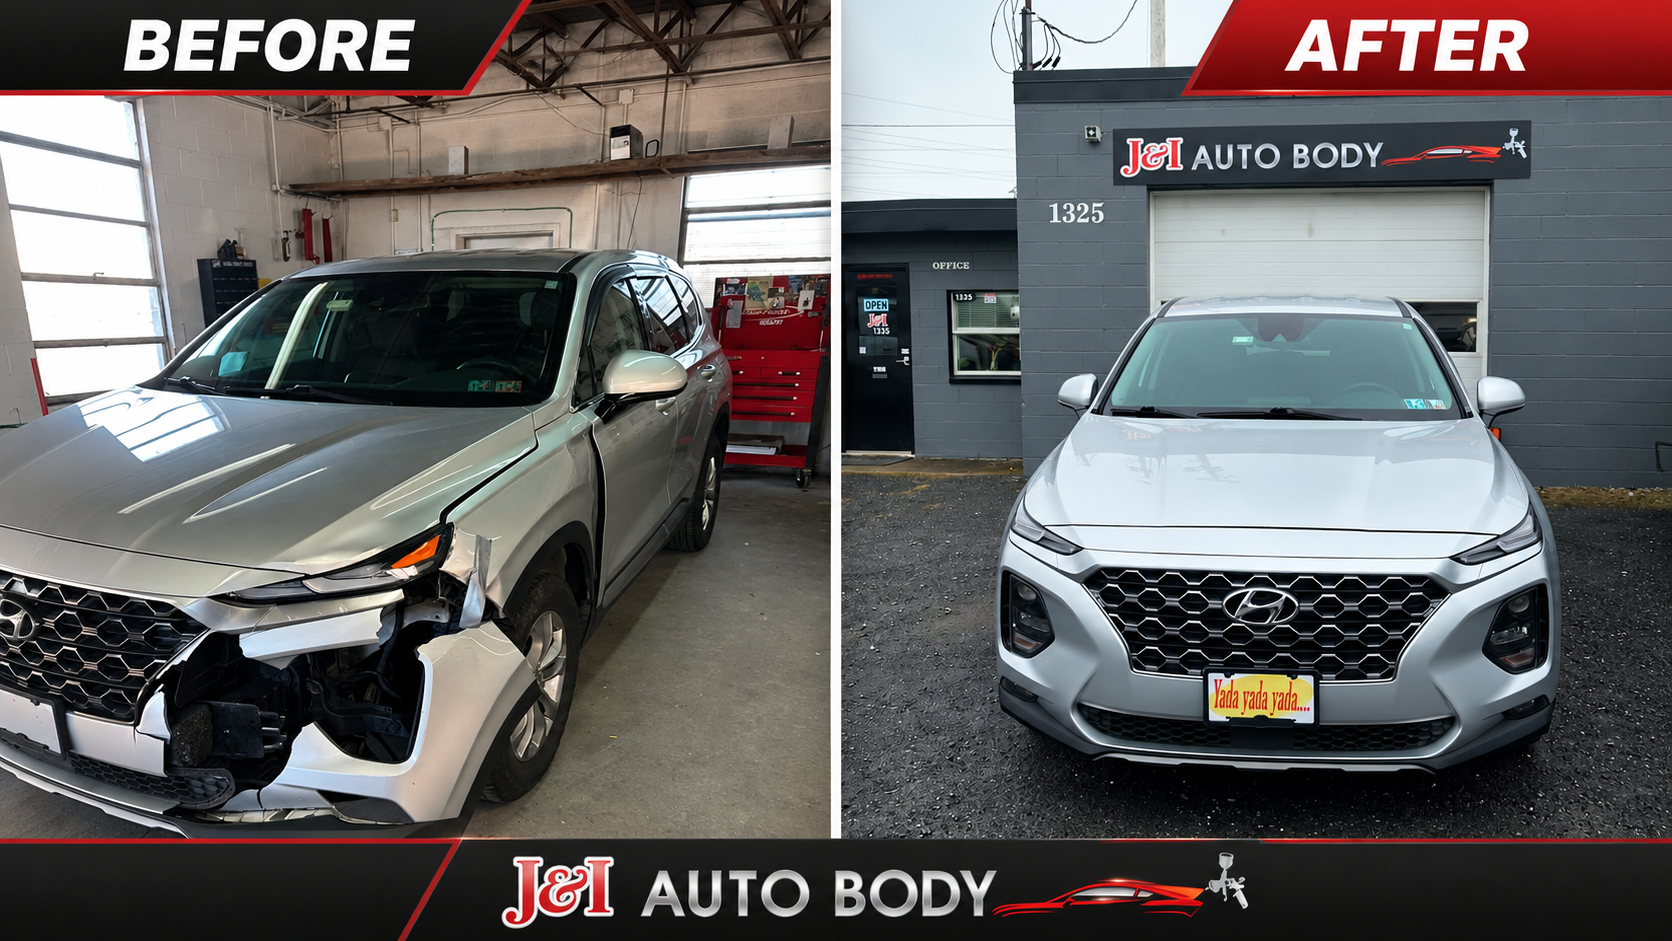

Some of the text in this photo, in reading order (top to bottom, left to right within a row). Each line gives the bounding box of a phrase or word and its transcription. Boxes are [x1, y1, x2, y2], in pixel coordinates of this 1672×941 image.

[1120, 137, 1384, 177] J&I AUTO BODY
[1049, 202, 1105, 224] 1325
[932, 261, 970, 270] OFFICE
[865, 300, 888, 310] OPEN
[1213, 678, 1239, 709] Yada
[1241, 680, 1268, 716] yada
